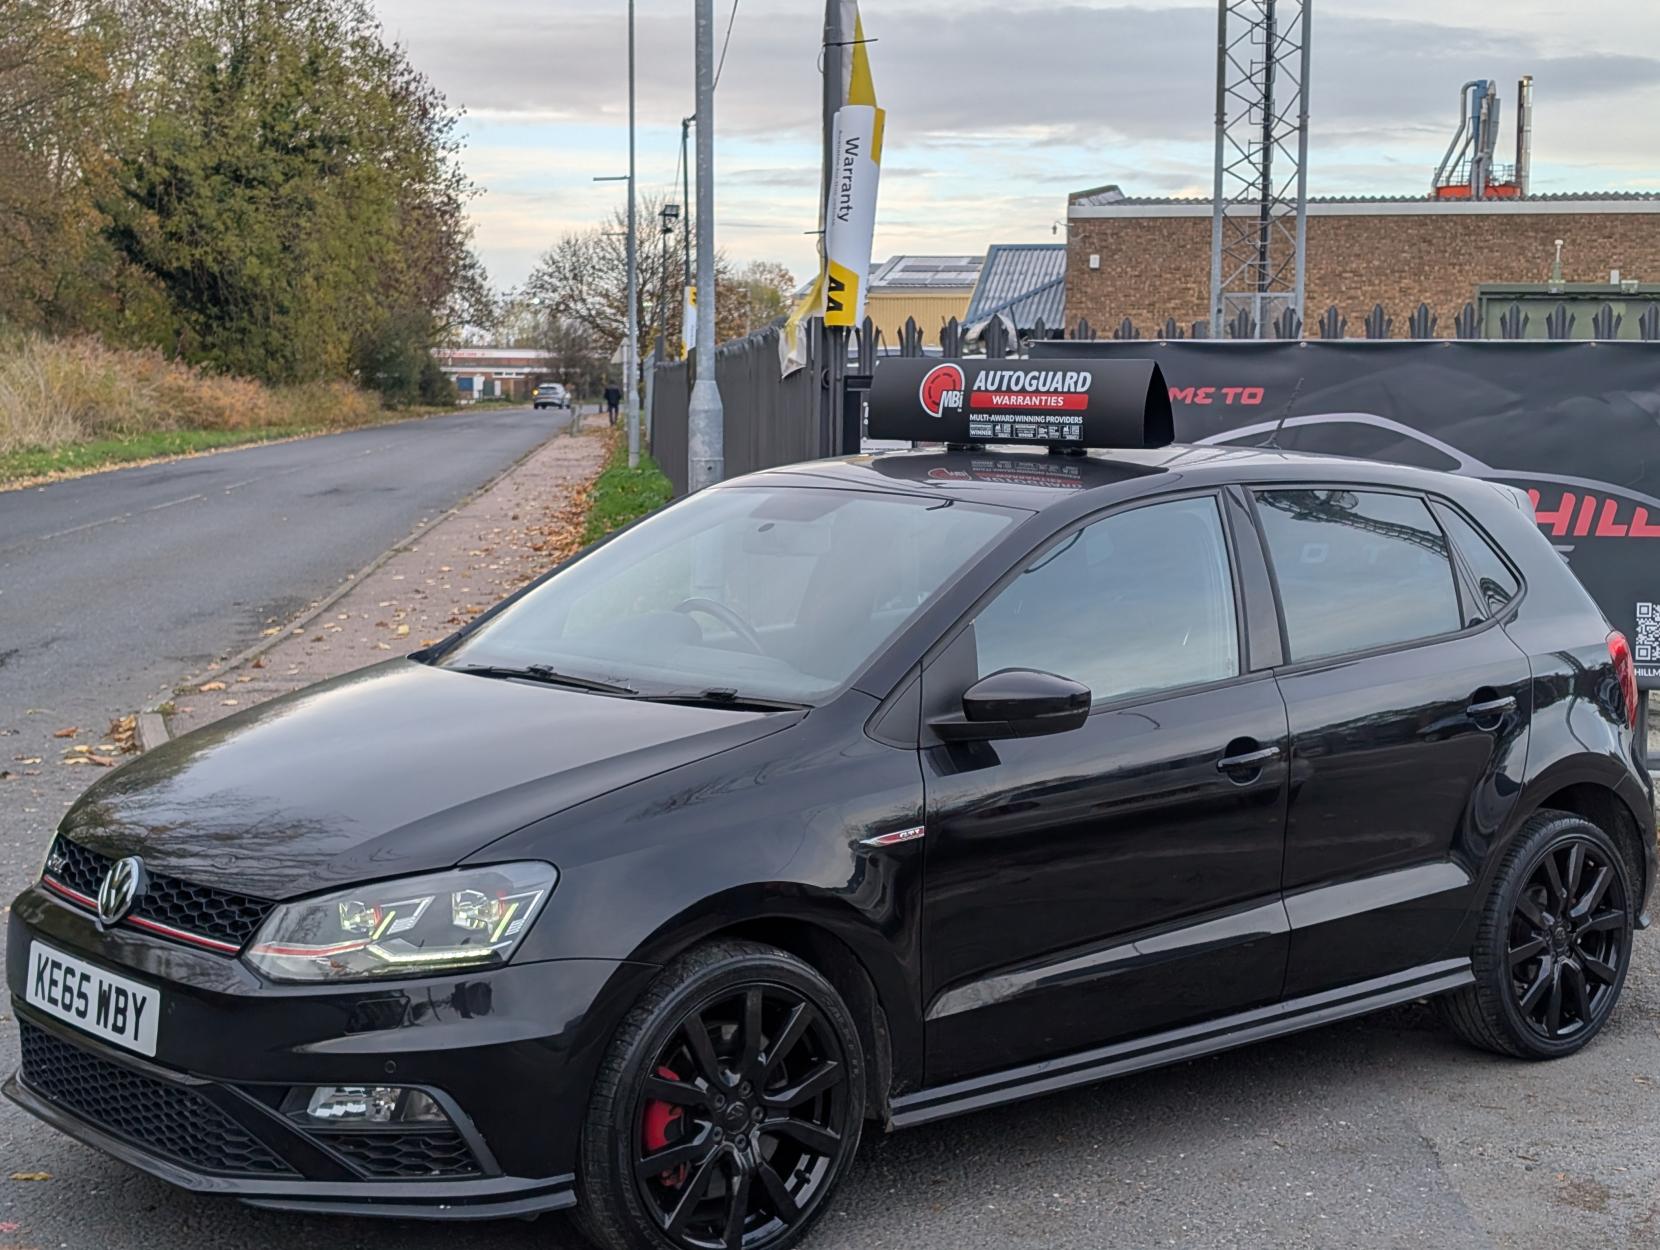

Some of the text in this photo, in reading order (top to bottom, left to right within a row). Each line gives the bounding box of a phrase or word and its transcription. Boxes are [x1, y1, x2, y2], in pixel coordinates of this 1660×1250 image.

[837, 137, 860, 222] Warranty
[826, 275, 845, 312] AA
[973, 370, 1092, 392] AUTOGUARD
[992, 395, 1064, 406] WARRANTIES
[1221, 387, 1265, 404] TO
[969, 414, 1083, 424] MULTI-AWARD WINNING PROVIDERS
[34, 952, 147, 1042] KE65 WBY
